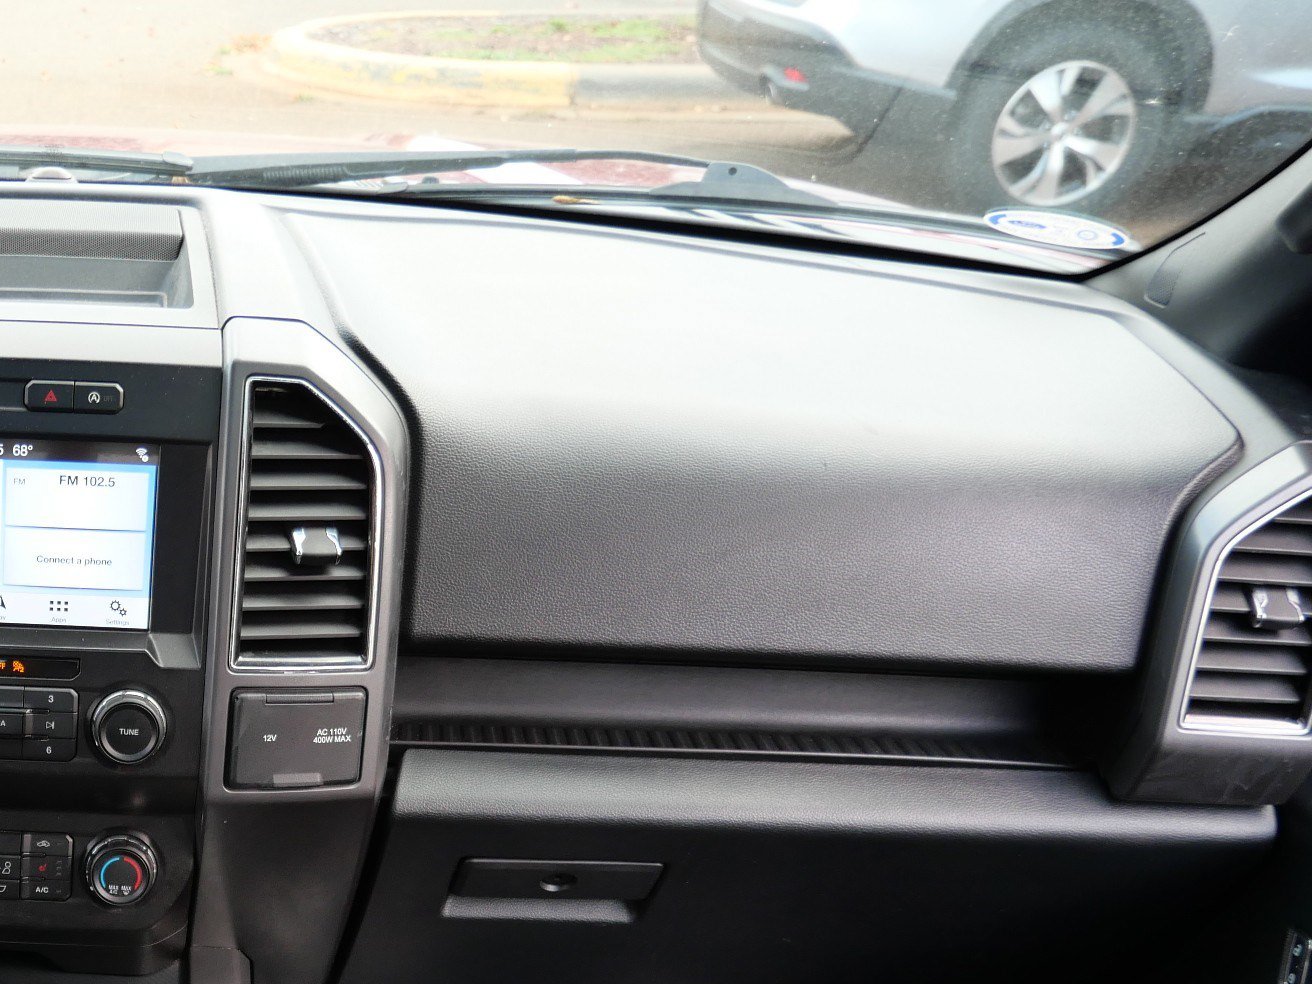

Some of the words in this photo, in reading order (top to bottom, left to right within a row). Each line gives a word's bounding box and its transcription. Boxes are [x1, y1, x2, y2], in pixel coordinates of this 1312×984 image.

[13, 477, 26, 486] FM
[59, 475, 79, 487] FM
[83, 476, 116, 488] 102.5
[36, 555, 75, 565] Connect
[84, 557, 112, 568] phone
[48, 695, 54, 704] 3
[119, 728, 139, 736] TUNE
[316, 728, 328, 736] AC
[329, 727, 347, 736] 110V
[262, 734, 277, 742] 12V
[313, 736, 333, 744] 400W
[334, 735, 352, 743] MAX
[46, 746, 52, 755] 6
[35, 886, 49, 894] A/C
